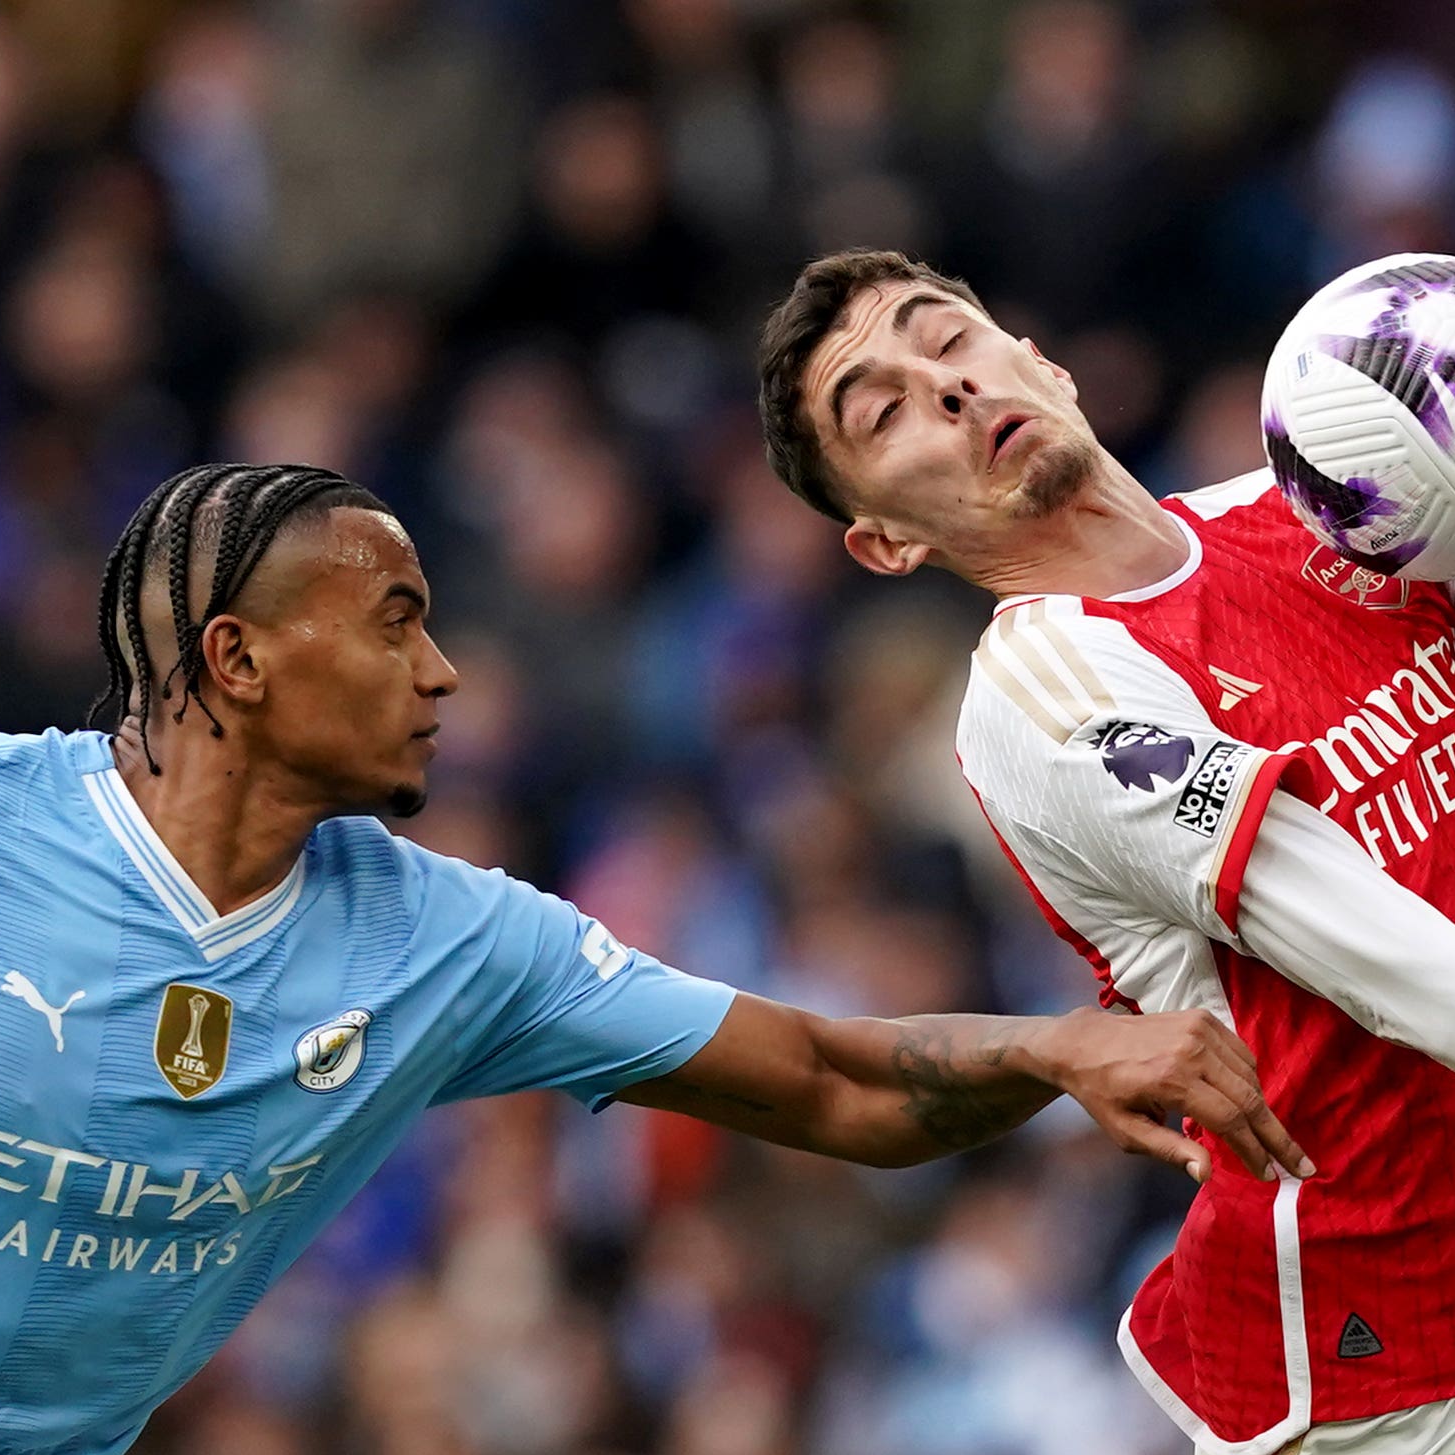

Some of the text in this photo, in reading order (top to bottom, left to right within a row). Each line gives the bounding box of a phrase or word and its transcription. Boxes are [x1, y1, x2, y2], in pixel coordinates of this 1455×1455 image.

[1173, 746, 1236, 832] No room
[1195, 799, 1222, 838] for
[1354, 779, 1430, 869] FLY
[173, 1054, 206, 1075] FIFA
[309, 1076, 336, 1086] CITY
